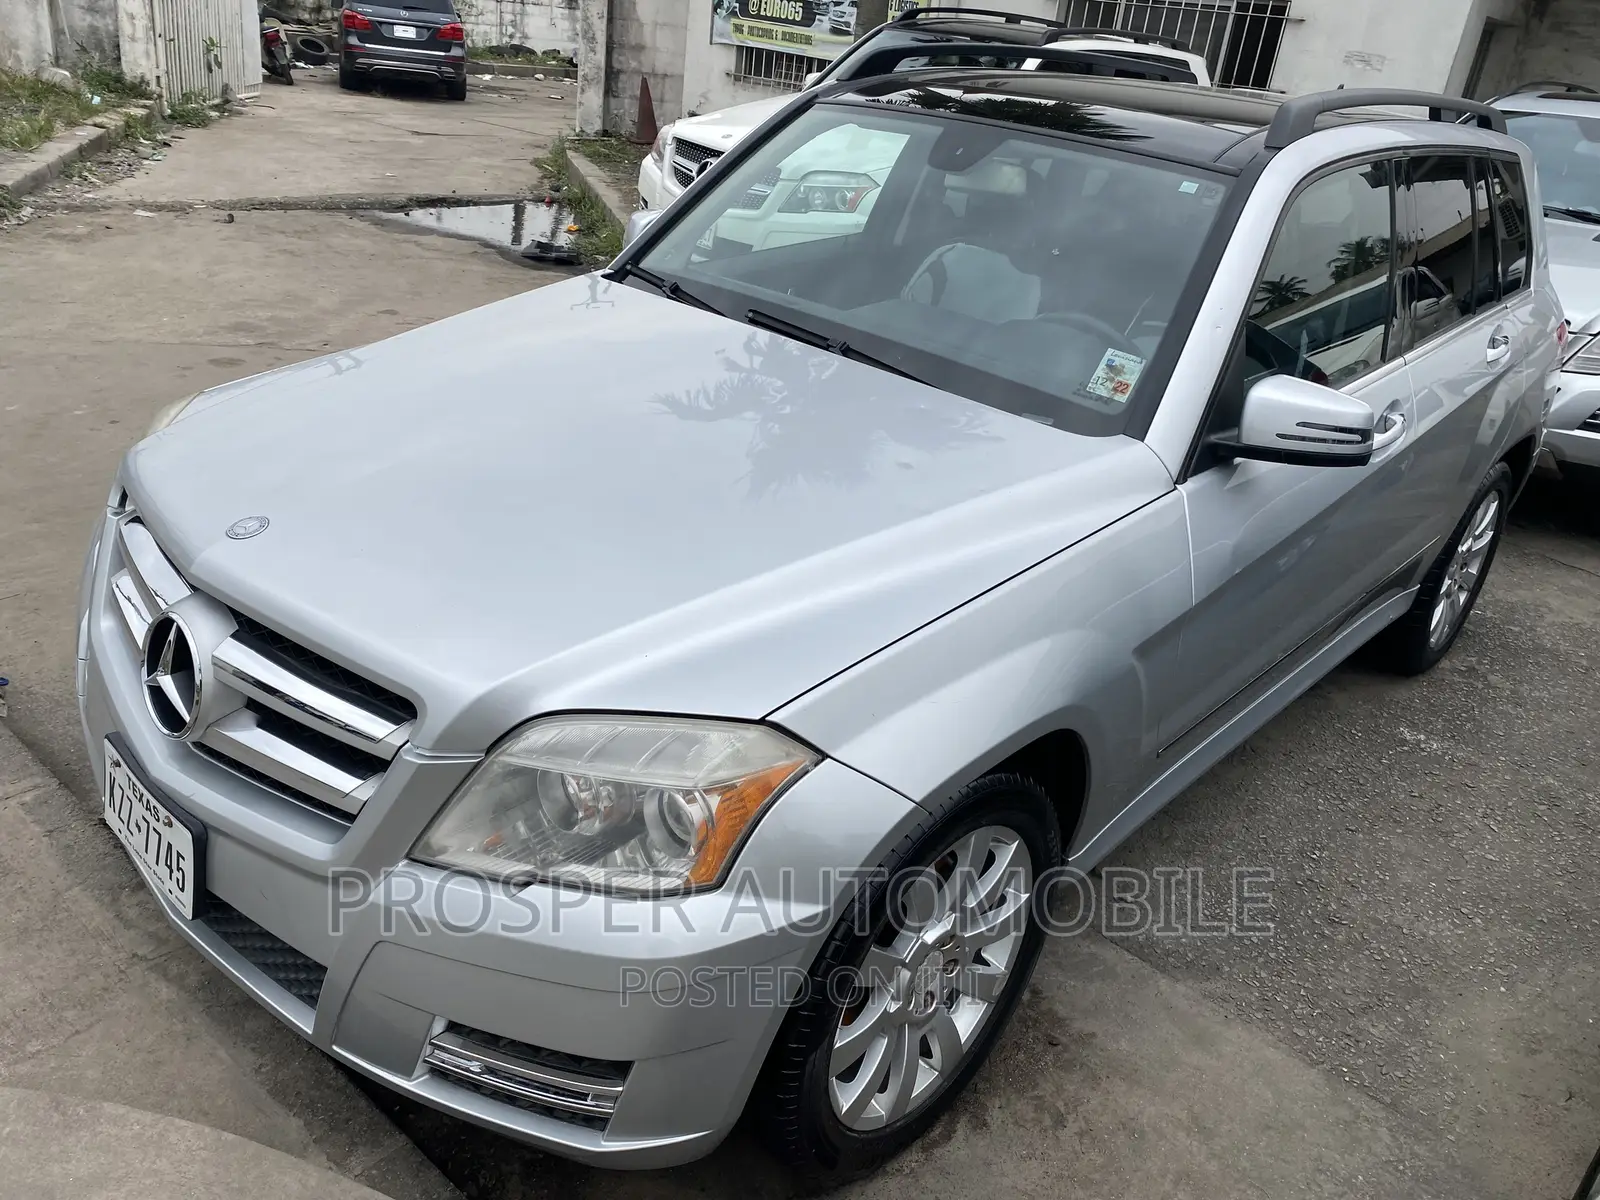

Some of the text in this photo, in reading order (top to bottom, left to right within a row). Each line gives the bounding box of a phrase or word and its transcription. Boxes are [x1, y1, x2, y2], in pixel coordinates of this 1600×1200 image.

[1094, 376, 1129, 394] 12 22
[126, 773, 160, 823] TEXAS
